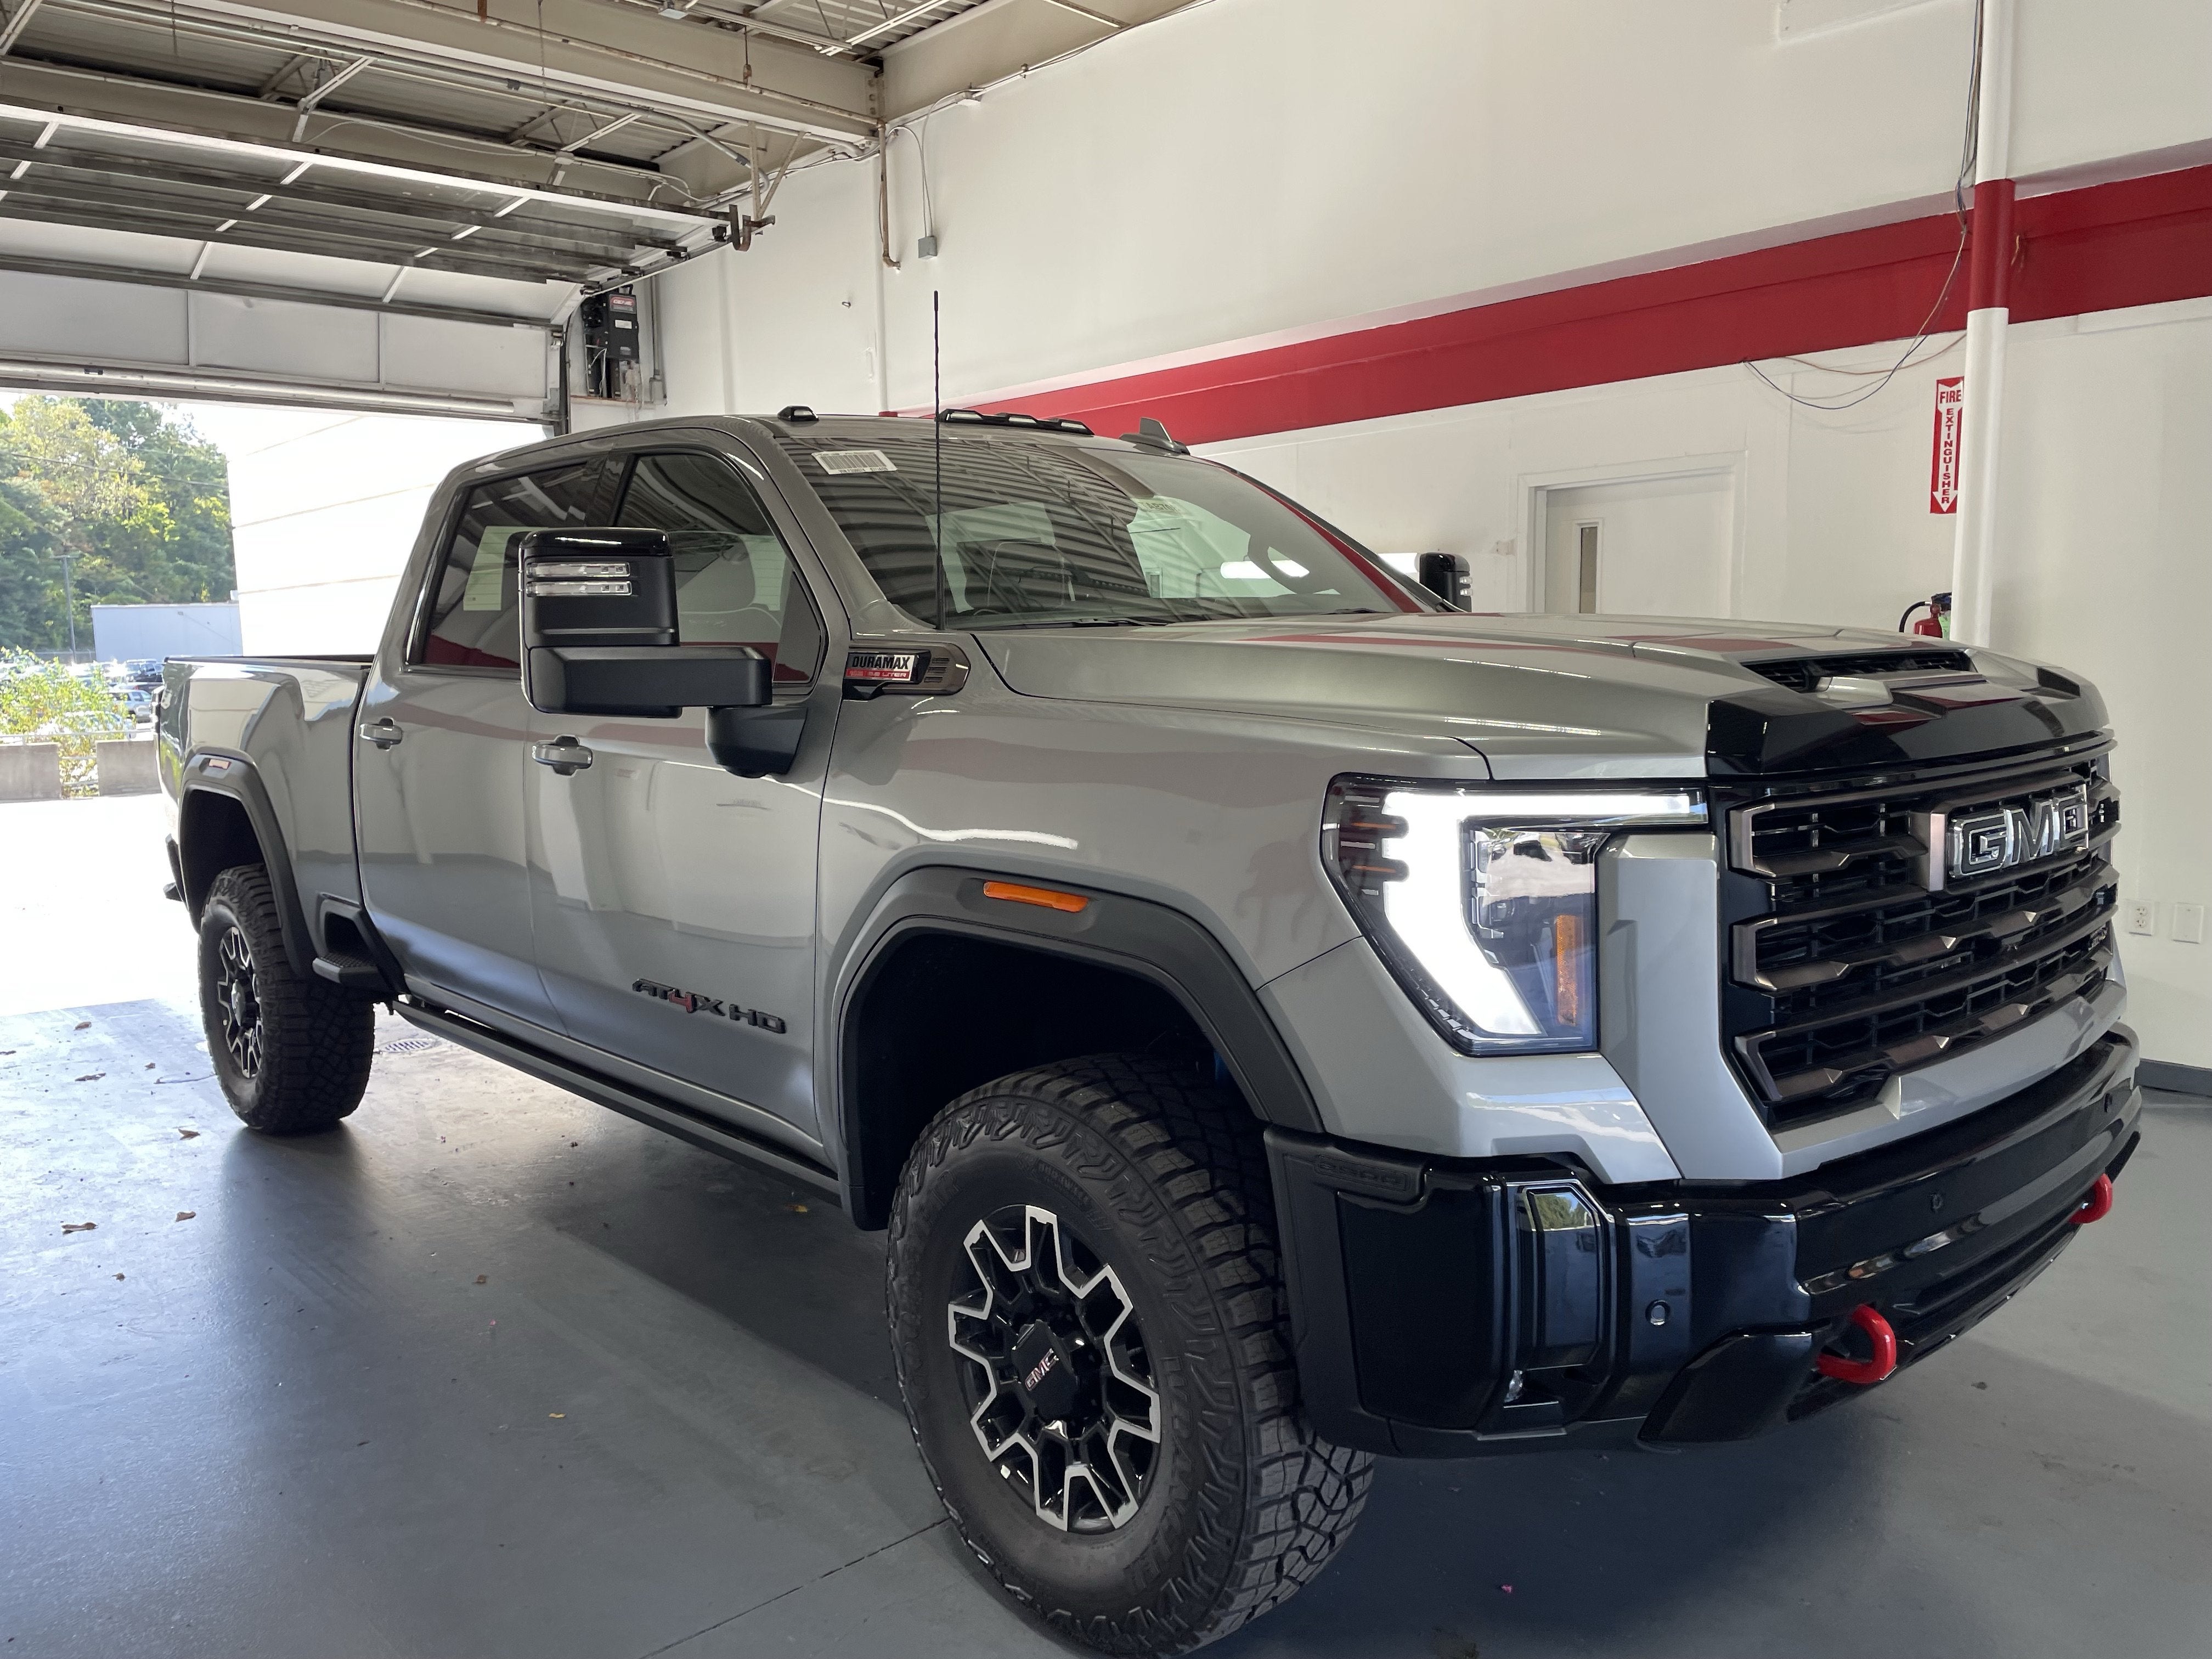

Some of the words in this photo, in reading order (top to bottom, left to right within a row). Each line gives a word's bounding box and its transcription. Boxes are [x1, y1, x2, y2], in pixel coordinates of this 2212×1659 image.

[1939, 390, 1961, 404] FIRE
[1941, 408, 1954, 504] EXTINGUISHER
[852, 656, 910, 669] DURAMAX
[1949, 785, 2089, 878] GMC
[729, 1003, 786, 1034] HD
[1025, 1348, 1059, 1391] GMC
